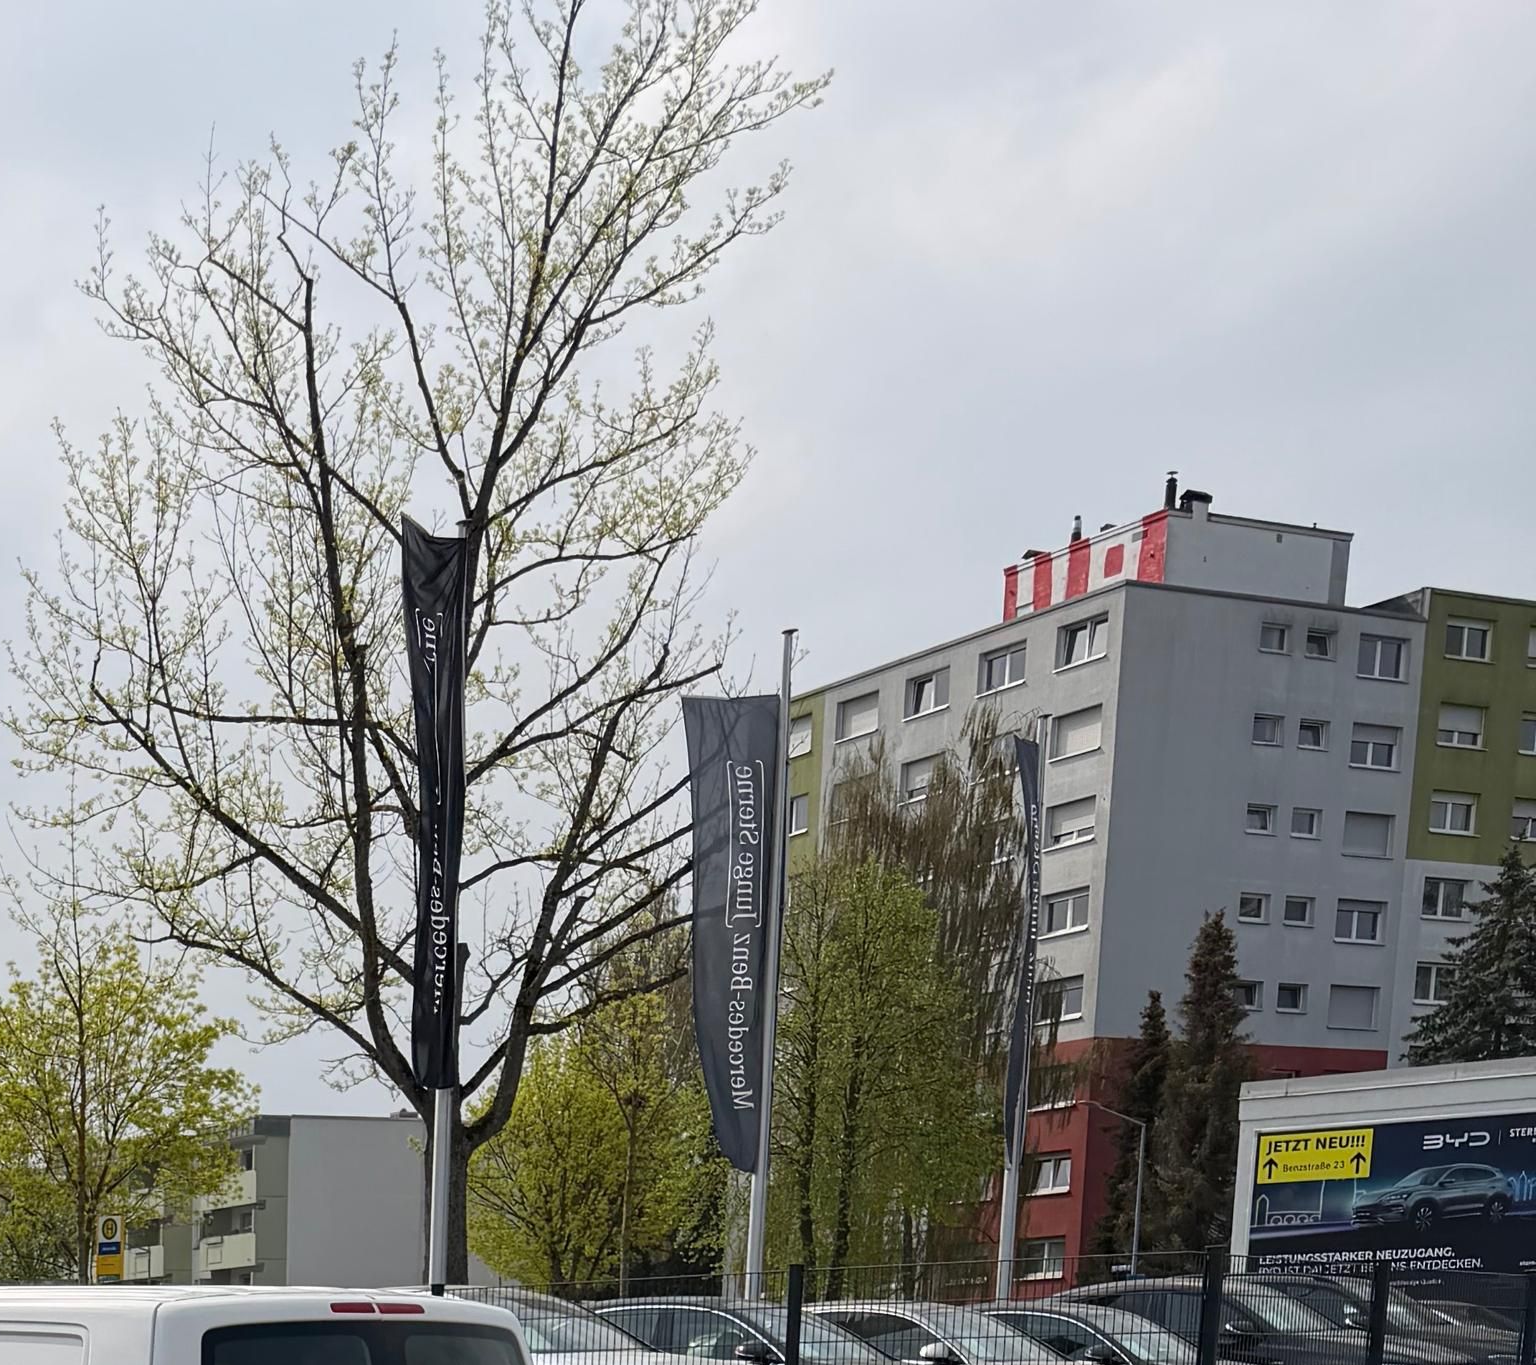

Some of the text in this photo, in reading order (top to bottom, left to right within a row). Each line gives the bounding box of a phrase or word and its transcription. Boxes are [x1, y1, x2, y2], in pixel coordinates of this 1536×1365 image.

[1266, 1135, 1365, 1156] JETZT NEU!!!
[1422, 1131, 1490, 1150] BYD
[1283, 1160, 1345, 1173] Benzstraße 23
[1259, 1247, 1455, 1265] LEISTUNGSSTARKER NEUZUGANG.
